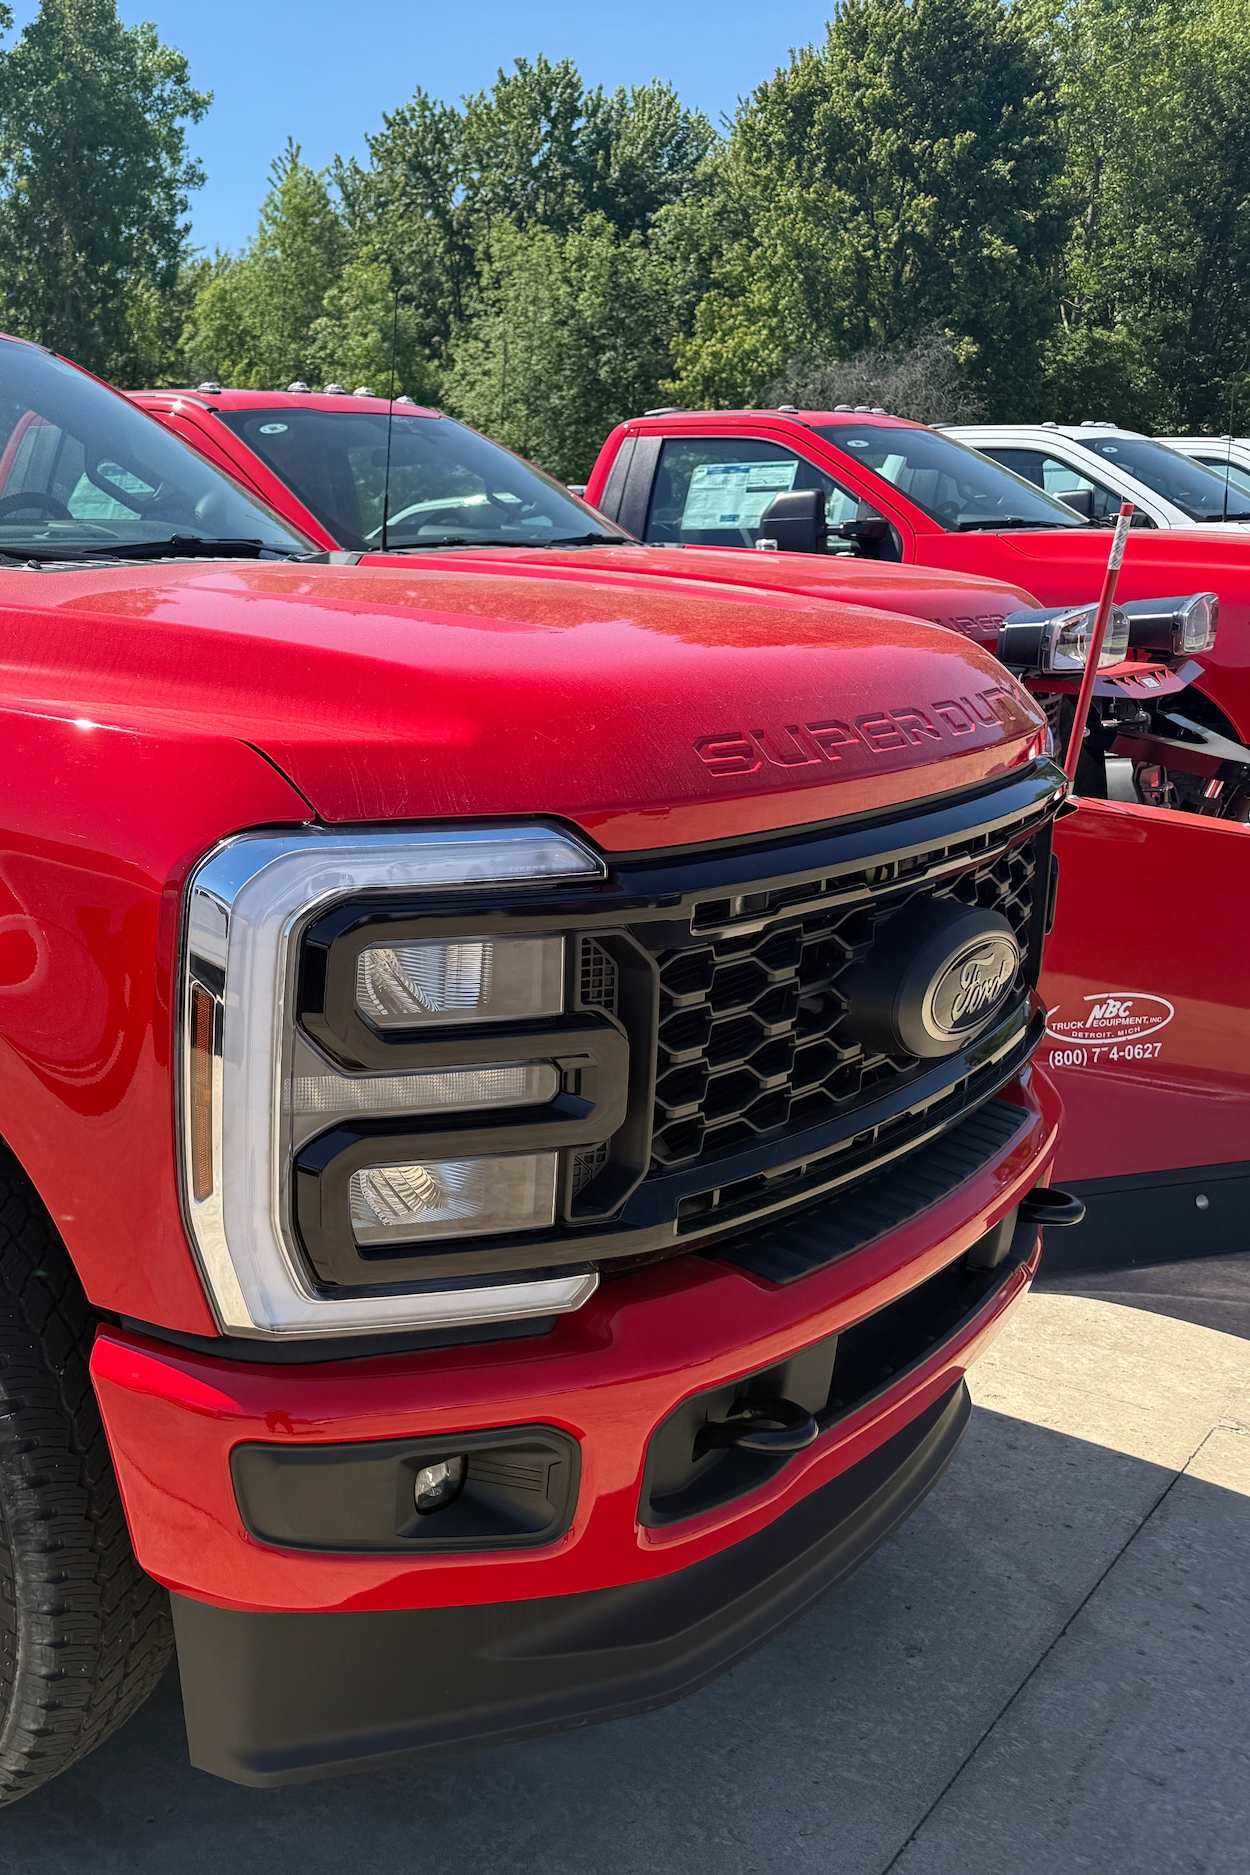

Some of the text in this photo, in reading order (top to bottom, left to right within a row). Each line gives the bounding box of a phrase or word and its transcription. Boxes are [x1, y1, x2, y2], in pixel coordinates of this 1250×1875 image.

[692, 682, 1031, 778] SUPER DUTY
[951, 952, 1006, 1022] Ford
[1051, 1021, 1085, 1031] TRUCK
[1092, 1015, 1149, 1027] EQUIPMENT,
[1085, 998, 1134, 1028] NBC
[1117, 1026, 1141, 1036] MICH
[1048, 1042, 1163, 1069] (800) 74-0627
